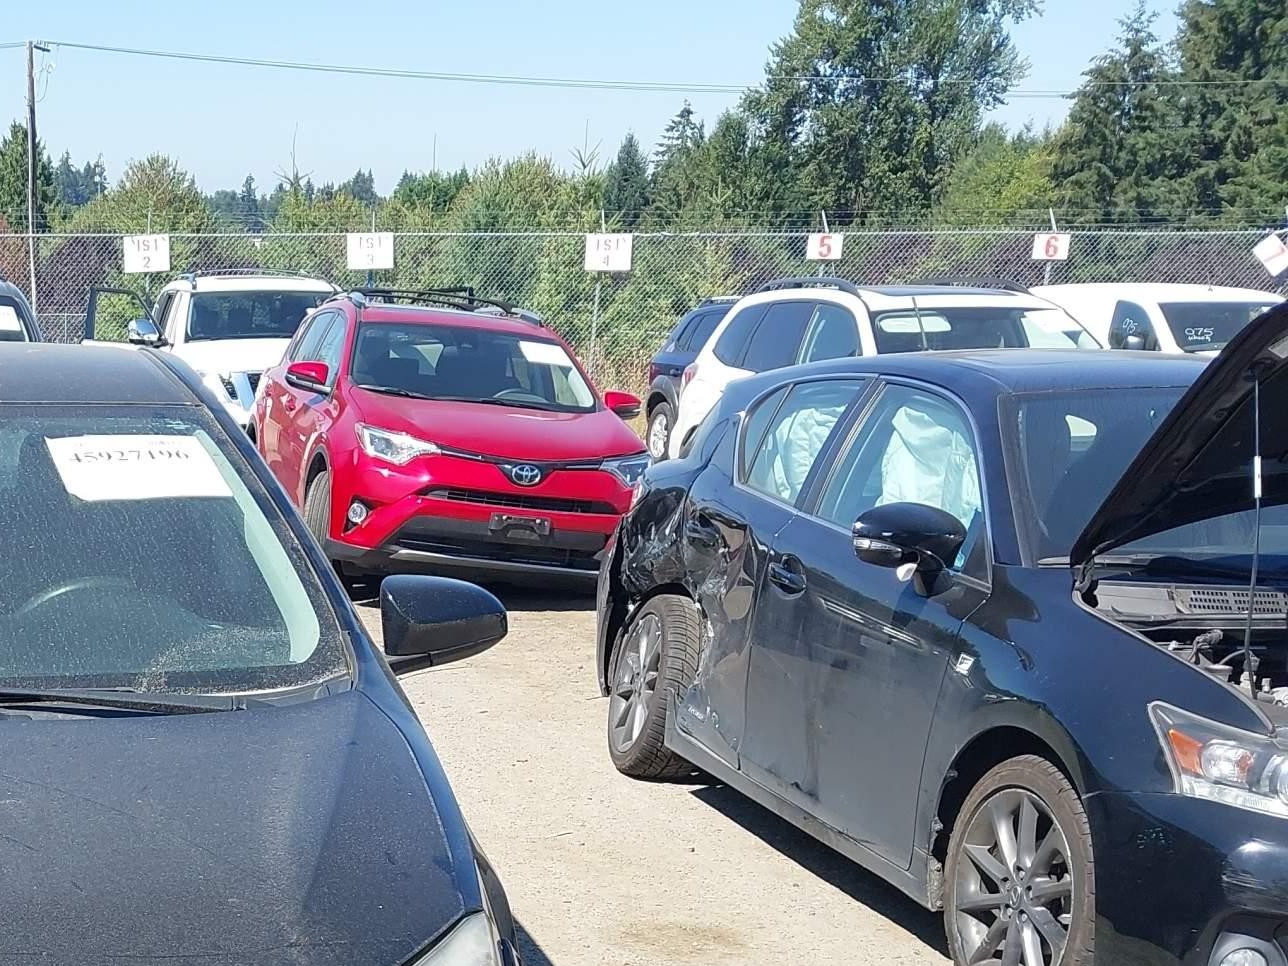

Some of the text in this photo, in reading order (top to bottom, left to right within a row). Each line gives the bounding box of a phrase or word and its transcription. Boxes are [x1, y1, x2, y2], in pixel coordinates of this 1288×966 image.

[818, 235, 832, 258] 5
[1044, 235, 1059, 258] 6
[142, 255, 152, 269] 2
[1184, 327, 1215, 337] 075
